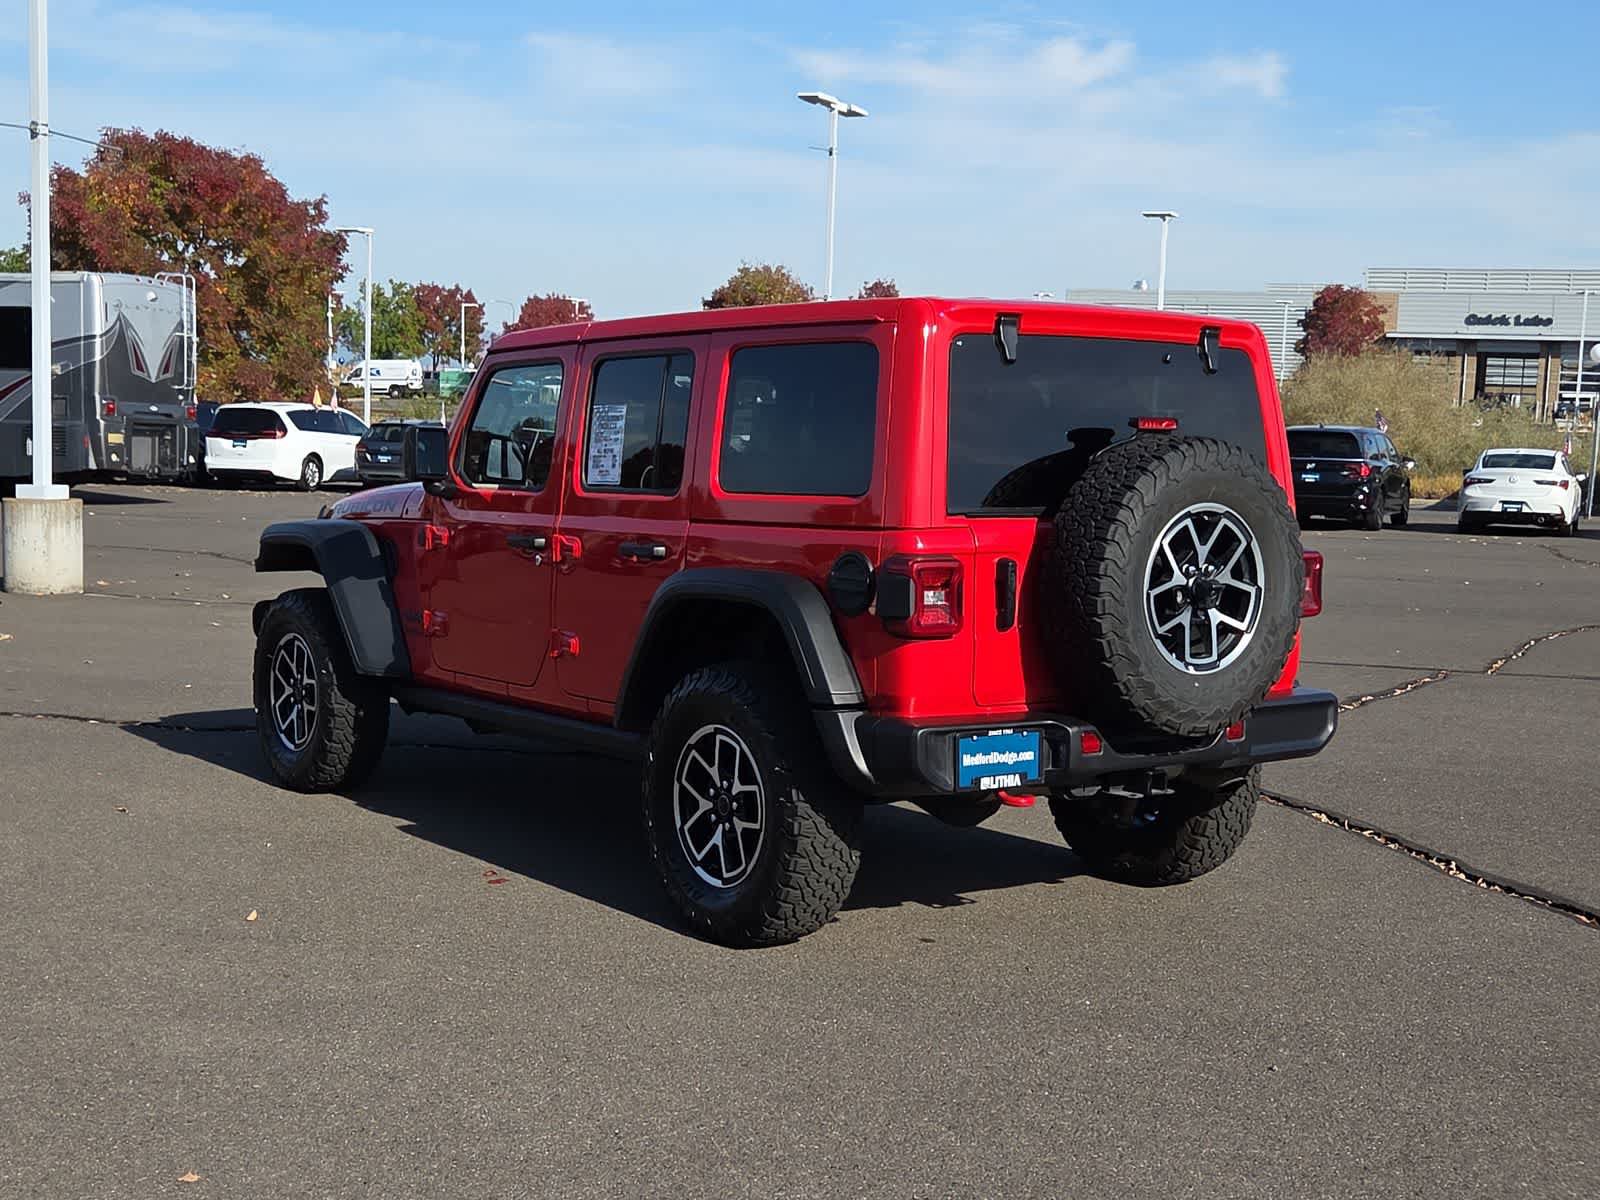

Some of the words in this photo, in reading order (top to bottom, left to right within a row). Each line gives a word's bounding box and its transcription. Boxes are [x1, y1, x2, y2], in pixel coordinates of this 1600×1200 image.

[1464, 313, 1511, 326] Quick
[1514, 314, 1553, 327] Lube
[962, 751, 1035, 767] MedfordDodge.com
[991, 773, 1022, 789] LITHIA
